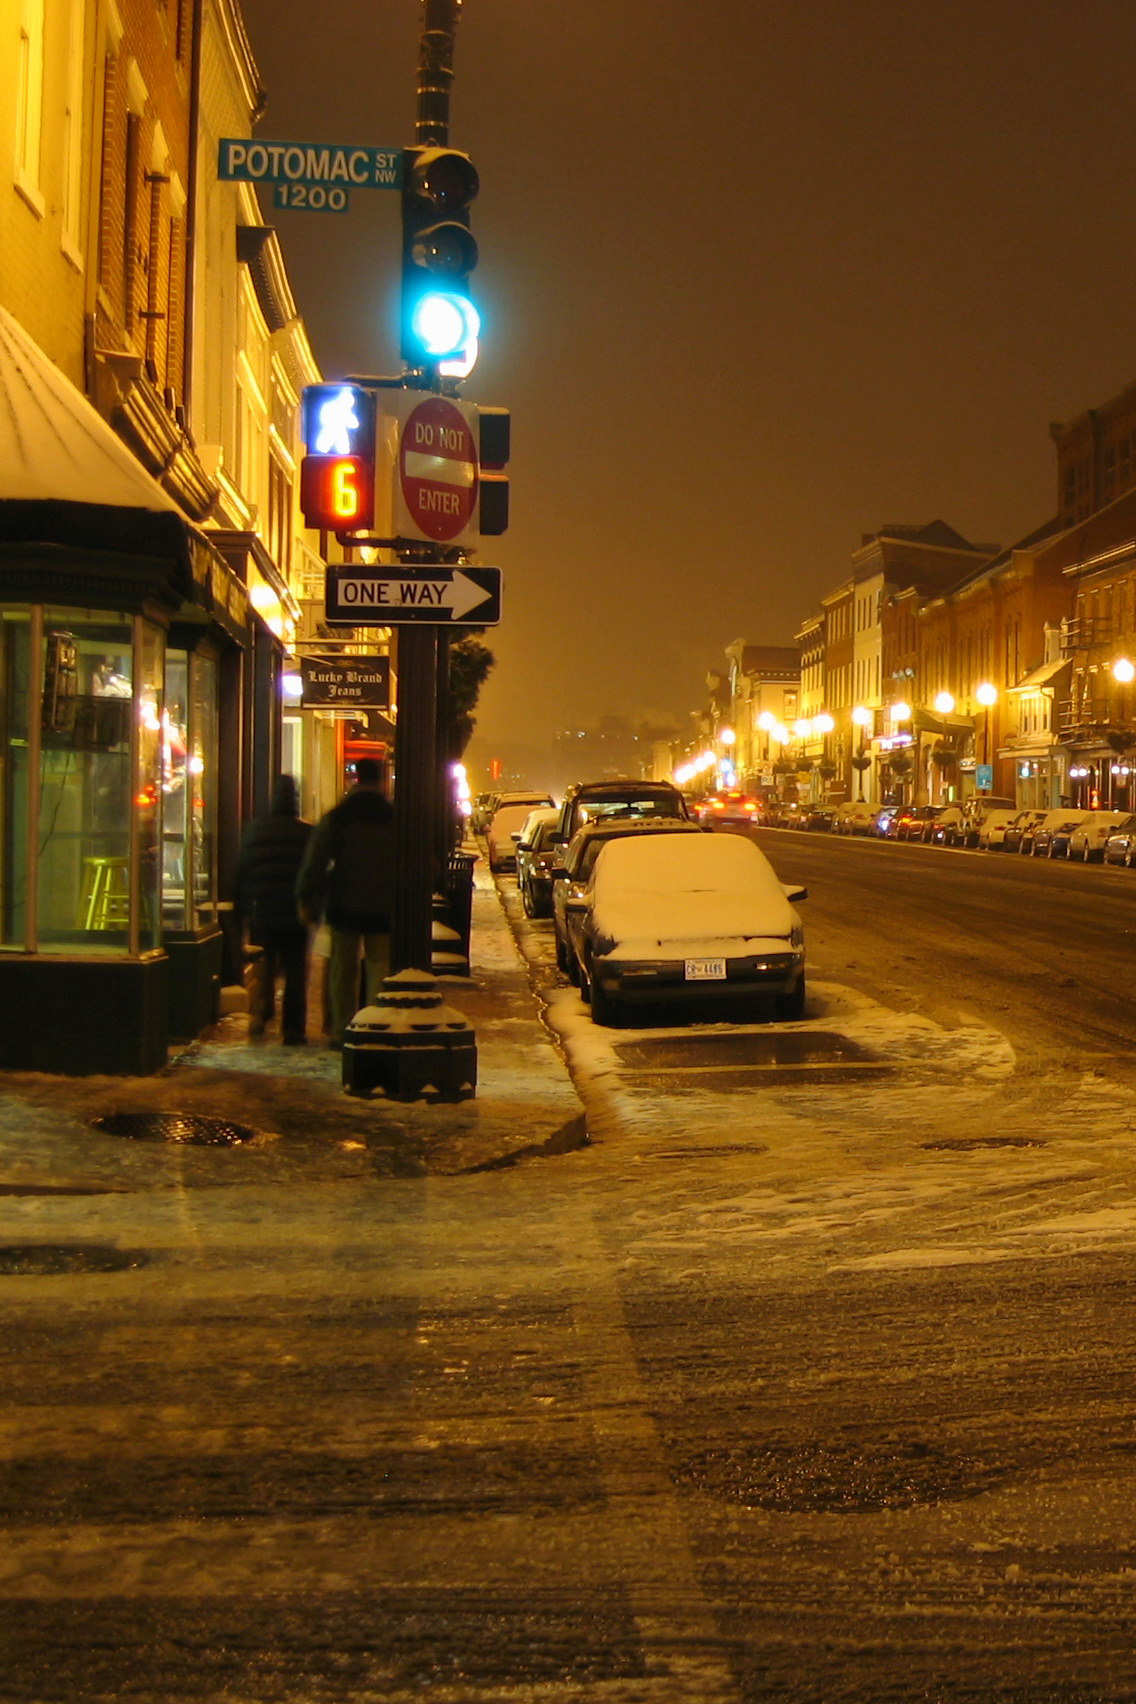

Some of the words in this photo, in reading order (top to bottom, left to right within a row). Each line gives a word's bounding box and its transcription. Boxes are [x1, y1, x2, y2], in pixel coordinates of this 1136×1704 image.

[228, 144, 370, 184] POTOMAC
[376, 153, 398, 168] ST
[375, 169, 397, 184] NW
[278, 185, 347, 210] 1200
[415, 423, 434, 446] DO
[439, 427, 464, 452] NOT
[333, 463, 358, 517] 6
[419, 488, 460, 516] ENTER
[344, 582, 390, 604] ONE
[400, 583, 448, 605] WAY
[308, 670, 343, 684] Lucky
[346, 670, 383, 684] Brand
[327, 684, 362, 698] Jeans
